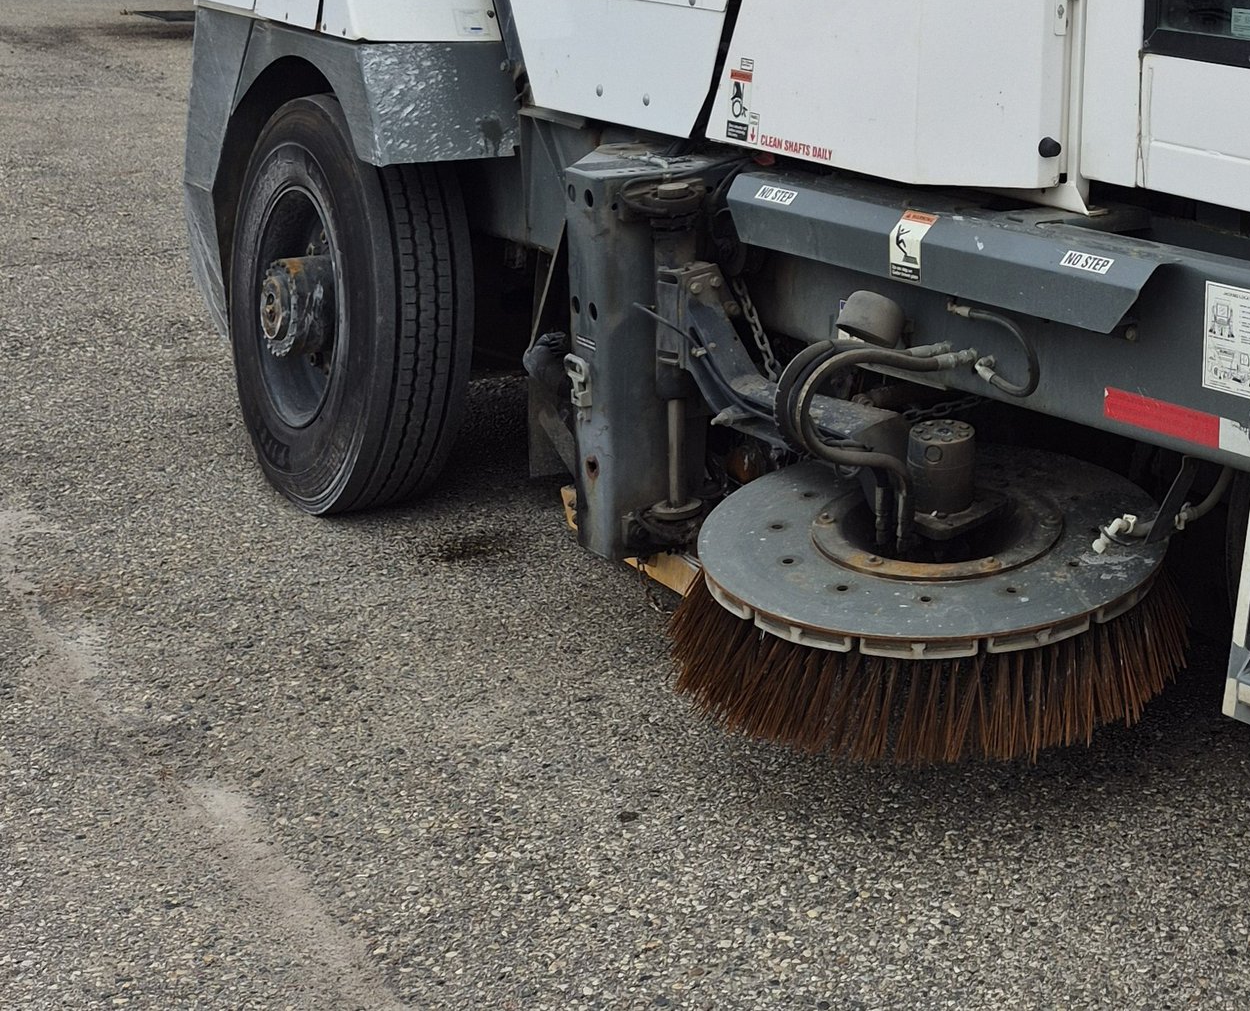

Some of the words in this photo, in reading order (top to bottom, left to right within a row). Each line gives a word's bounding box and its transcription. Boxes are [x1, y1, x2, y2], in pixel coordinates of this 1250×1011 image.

[760, 134, 782, 149] CLEAN
[784, 140, 811, 156] SHAFTS
[812, 146, 833, 160] DAILY
[757, 187, 772, 199] NO
[771, 190, 793, 203] STEP
[1064, 253, 1082, 265] NO
[1082, 256, 1110, 271] STEP
